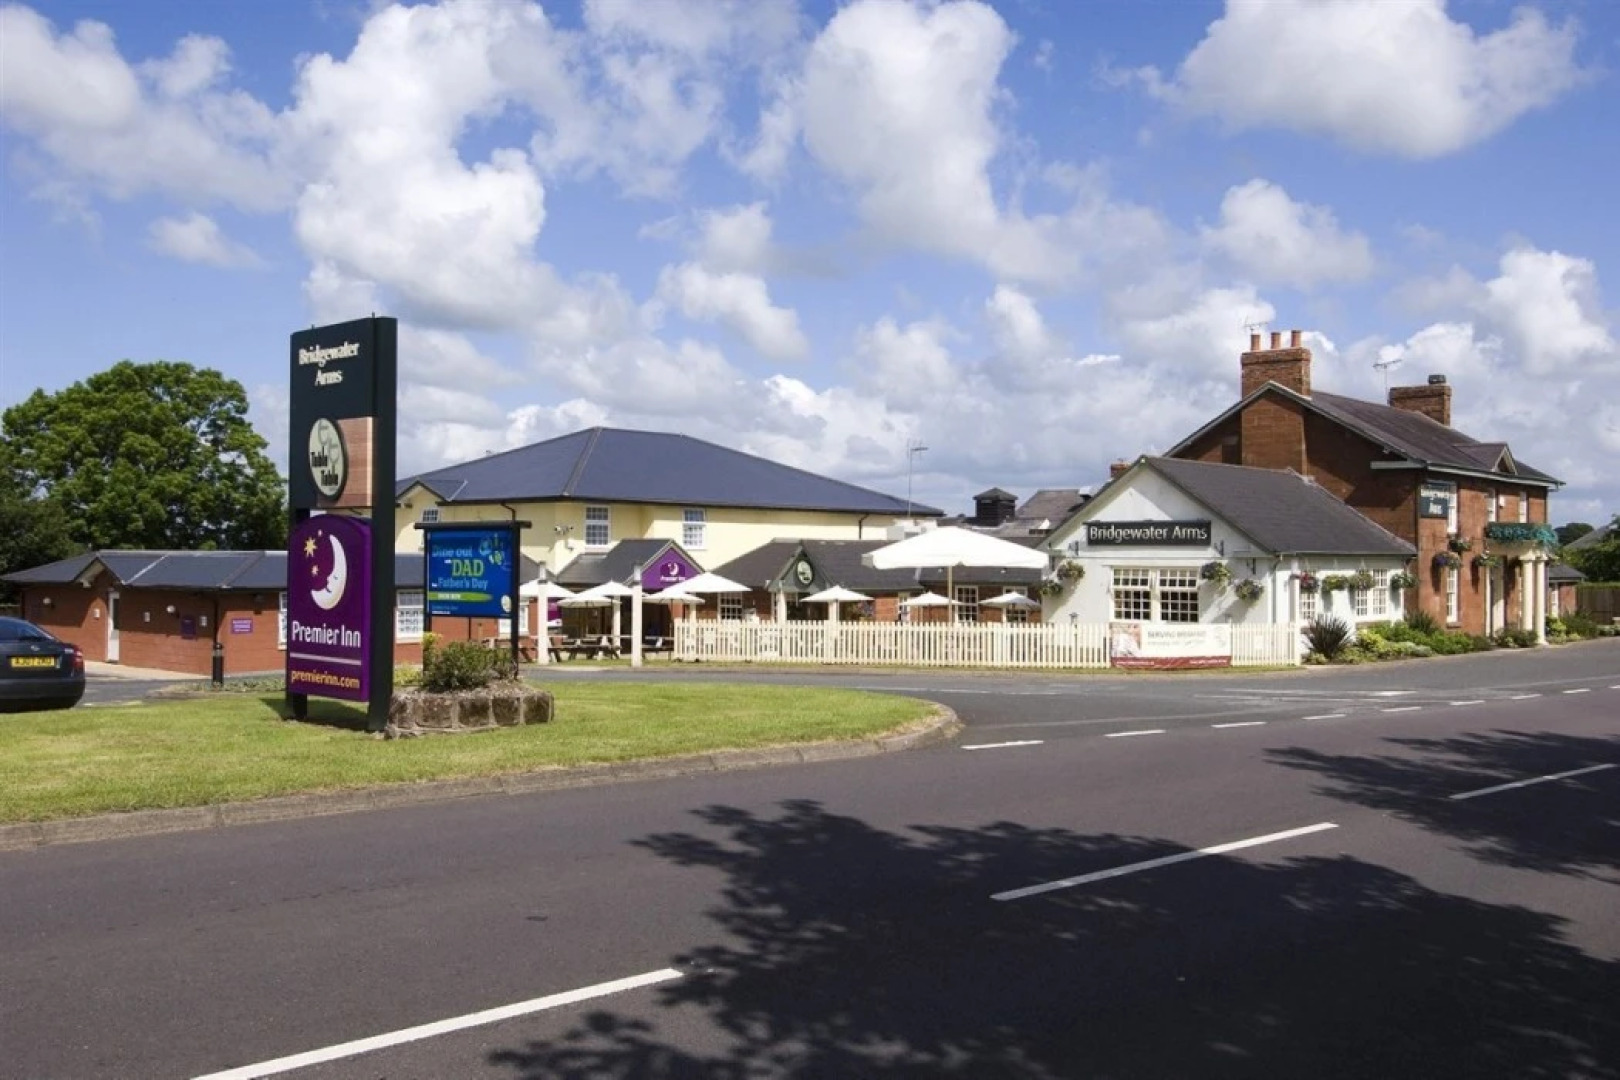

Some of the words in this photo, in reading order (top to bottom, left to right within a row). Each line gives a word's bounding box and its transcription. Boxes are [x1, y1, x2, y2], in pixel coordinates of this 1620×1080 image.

[299, 341, 360, 367] Bridgewater
[315, 369, 343, 386] Arms
[1090, 525, 1168, 543] Bridgewater
[1171, 525, 1208, 540] Arms
[452, 559, 484, 577] DAD
[472, 578, 488, 590] Day
[292, 621, 339, 645] Premier
[341, 625, 361, 648] Inn
[291, 669, 360, 689] premierinn.com
